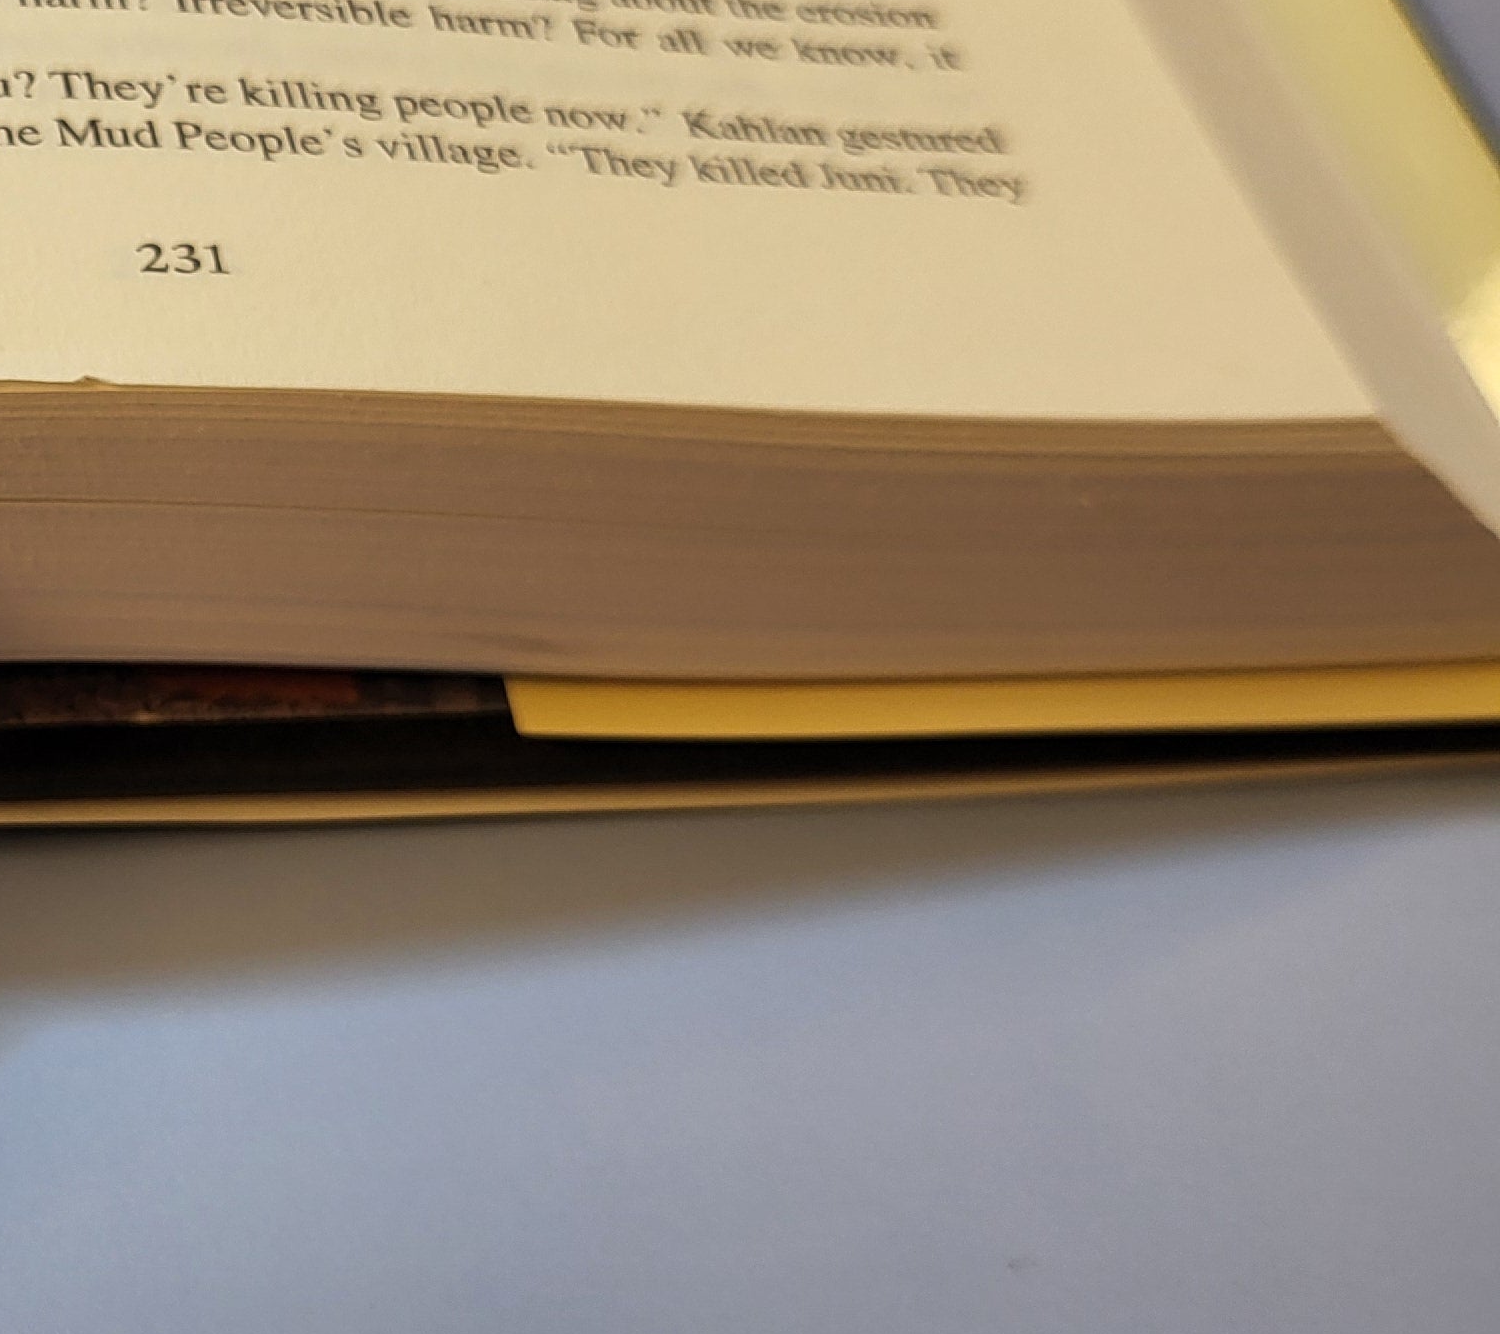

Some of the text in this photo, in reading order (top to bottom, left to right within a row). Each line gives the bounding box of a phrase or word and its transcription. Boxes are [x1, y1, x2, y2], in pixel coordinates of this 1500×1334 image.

[428, 3, 554, 41] harm?
[571, 16, 643, 50] For
[657, 25, 709, 56] all
[723, 36, 784, 62] we
[927, 42, 962, 71] it
[795, 0, 940, 30] erosion
[47, 69, 228, 110] They're
[239, 75, 383, 122] killing
[393, 93, 533, 129] people
[543, 104, 661, 134] now."
[682, 107, 831, 147] Kahlan
[835, 124, 1008, 156] gestured
[57, 116, 163, 149] Mud
[175, 119, 365, 162] People's
[546, 142, 681, 188] "They
[689, 153, 815, 189] killed
[915, 162, 1029, 206] They
[135, 242, 232, 276] 231
